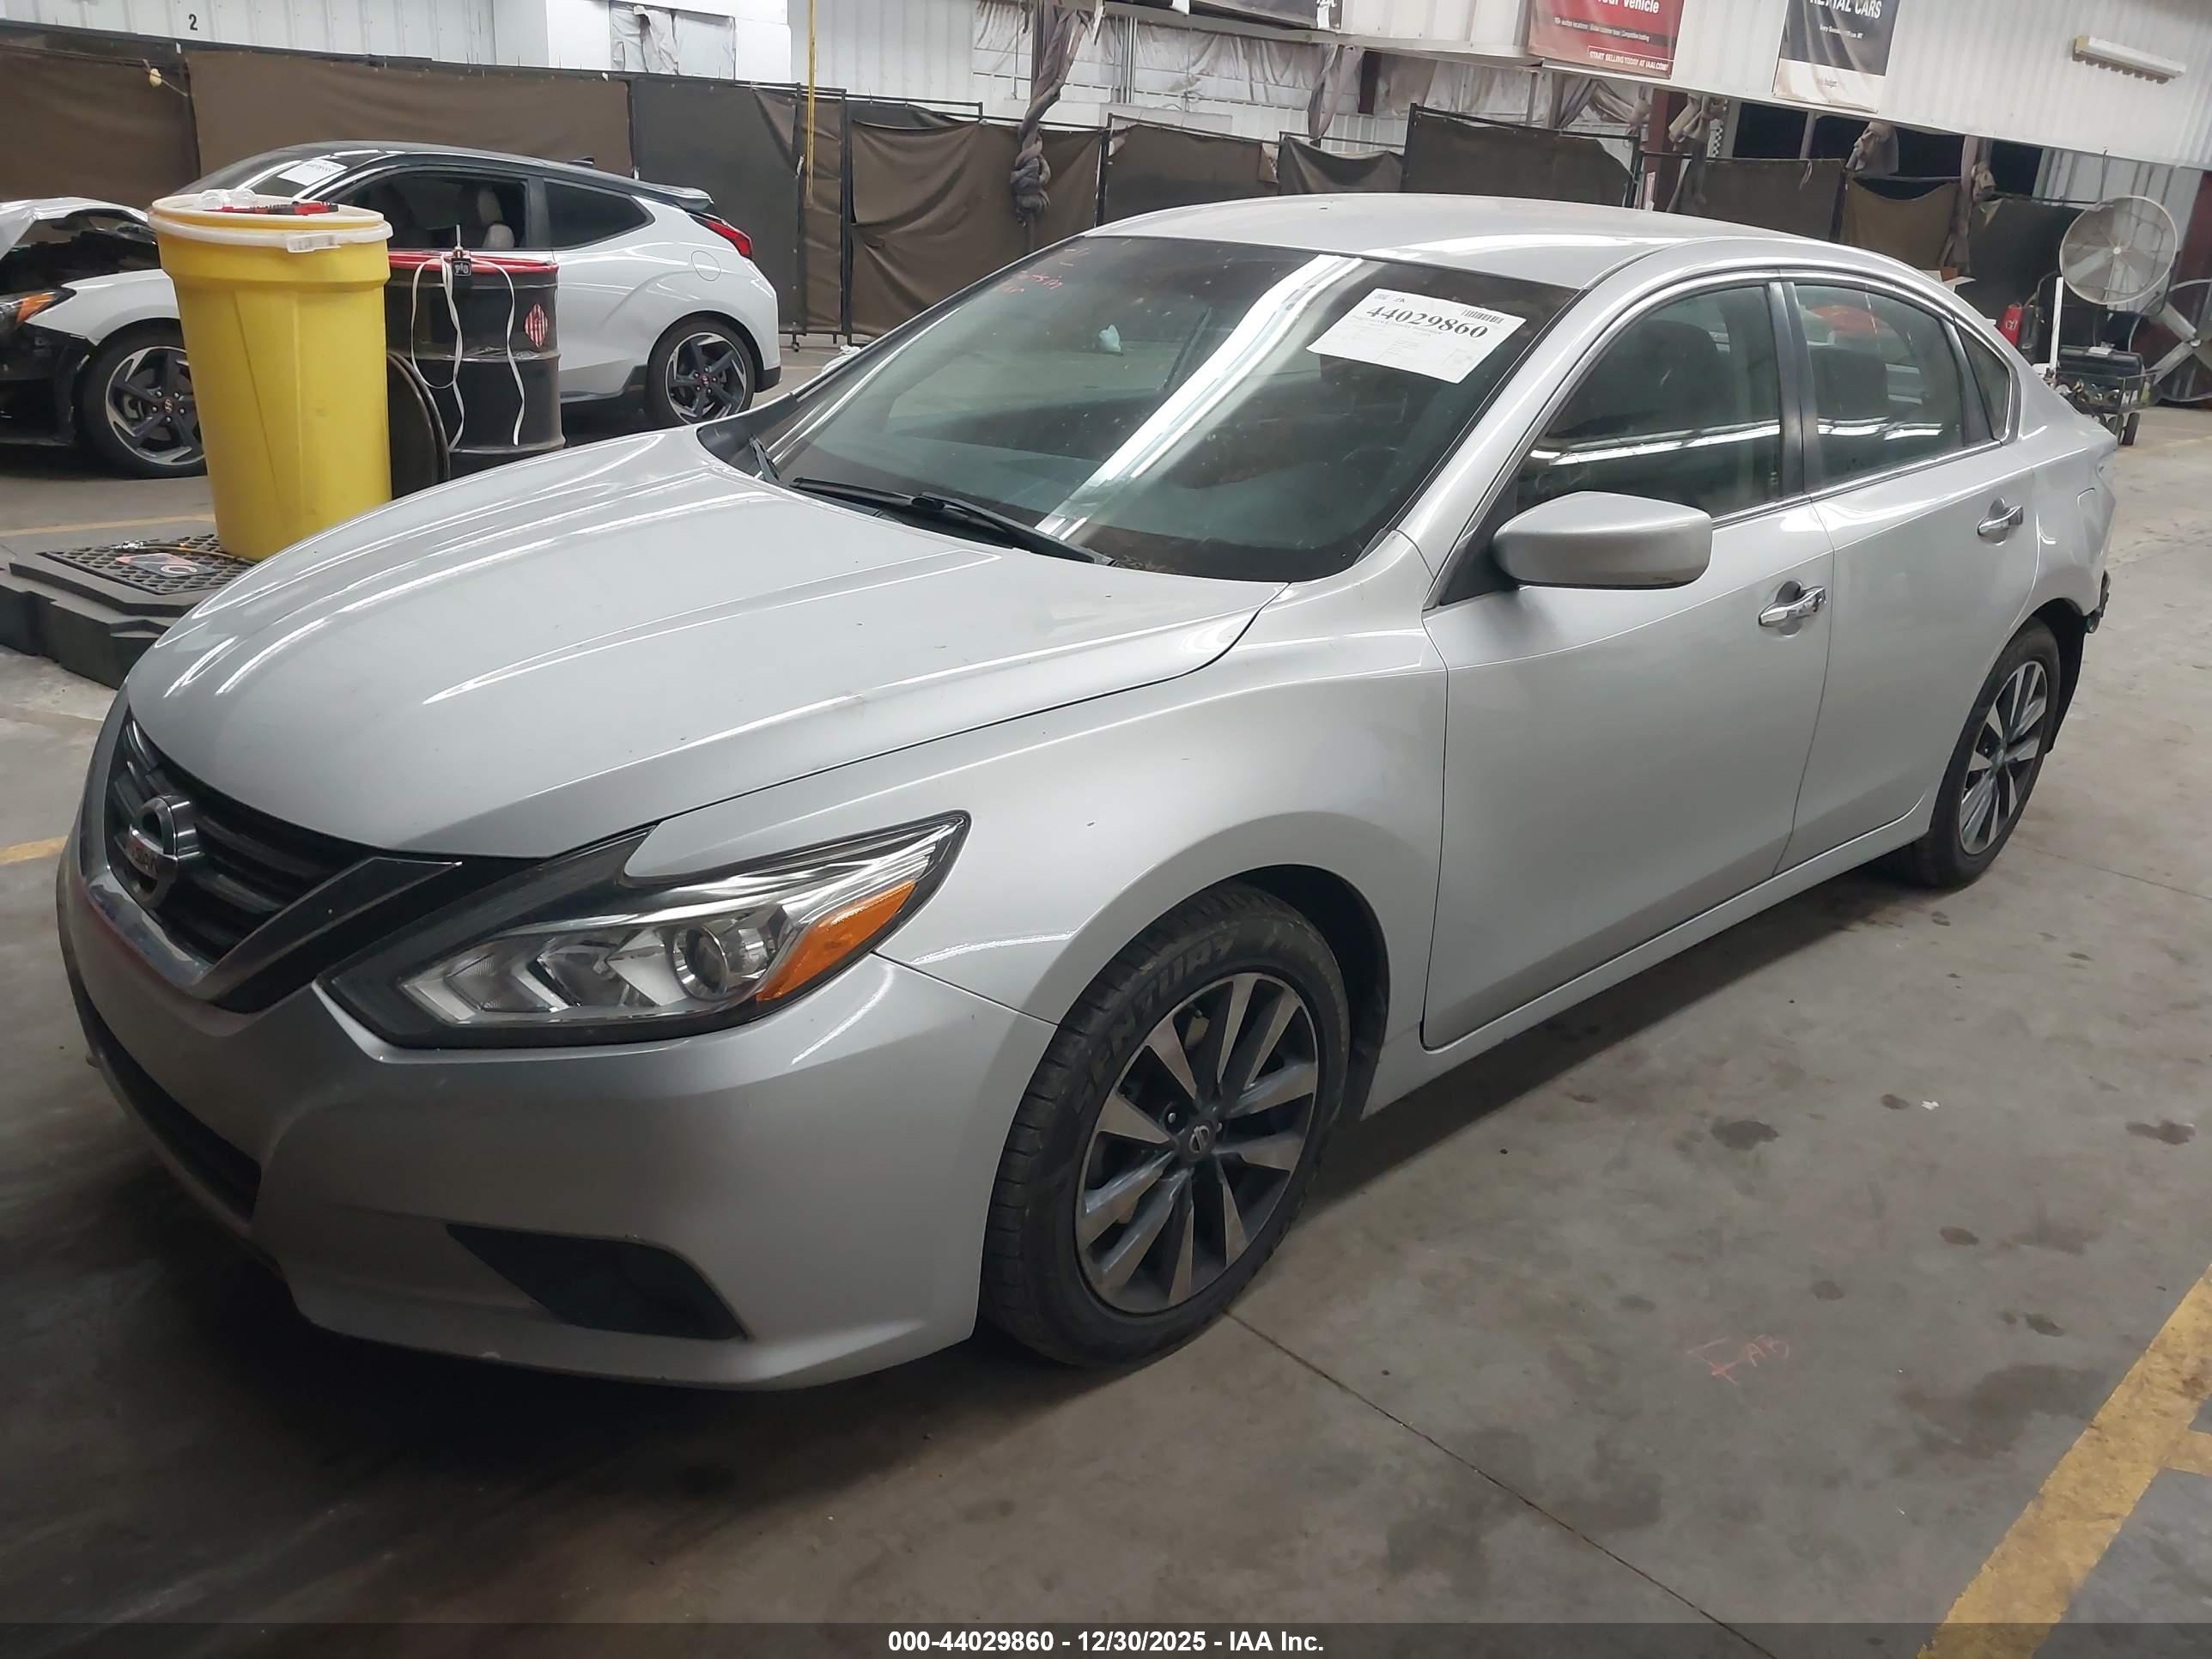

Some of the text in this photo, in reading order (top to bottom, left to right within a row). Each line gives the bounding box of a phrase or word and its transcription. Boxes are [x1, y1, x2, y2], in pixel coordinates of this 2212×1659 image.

[1810, 0, 1882, 19] TAL CARS
[188, 13, 198, 32] 2
[1589, 51, 1605, 61] START
[1605, 52, 1625, 64] SELLING
[1638, 58, 1647, 67] AT
[1366, 305, 1488, 339] 44029860
